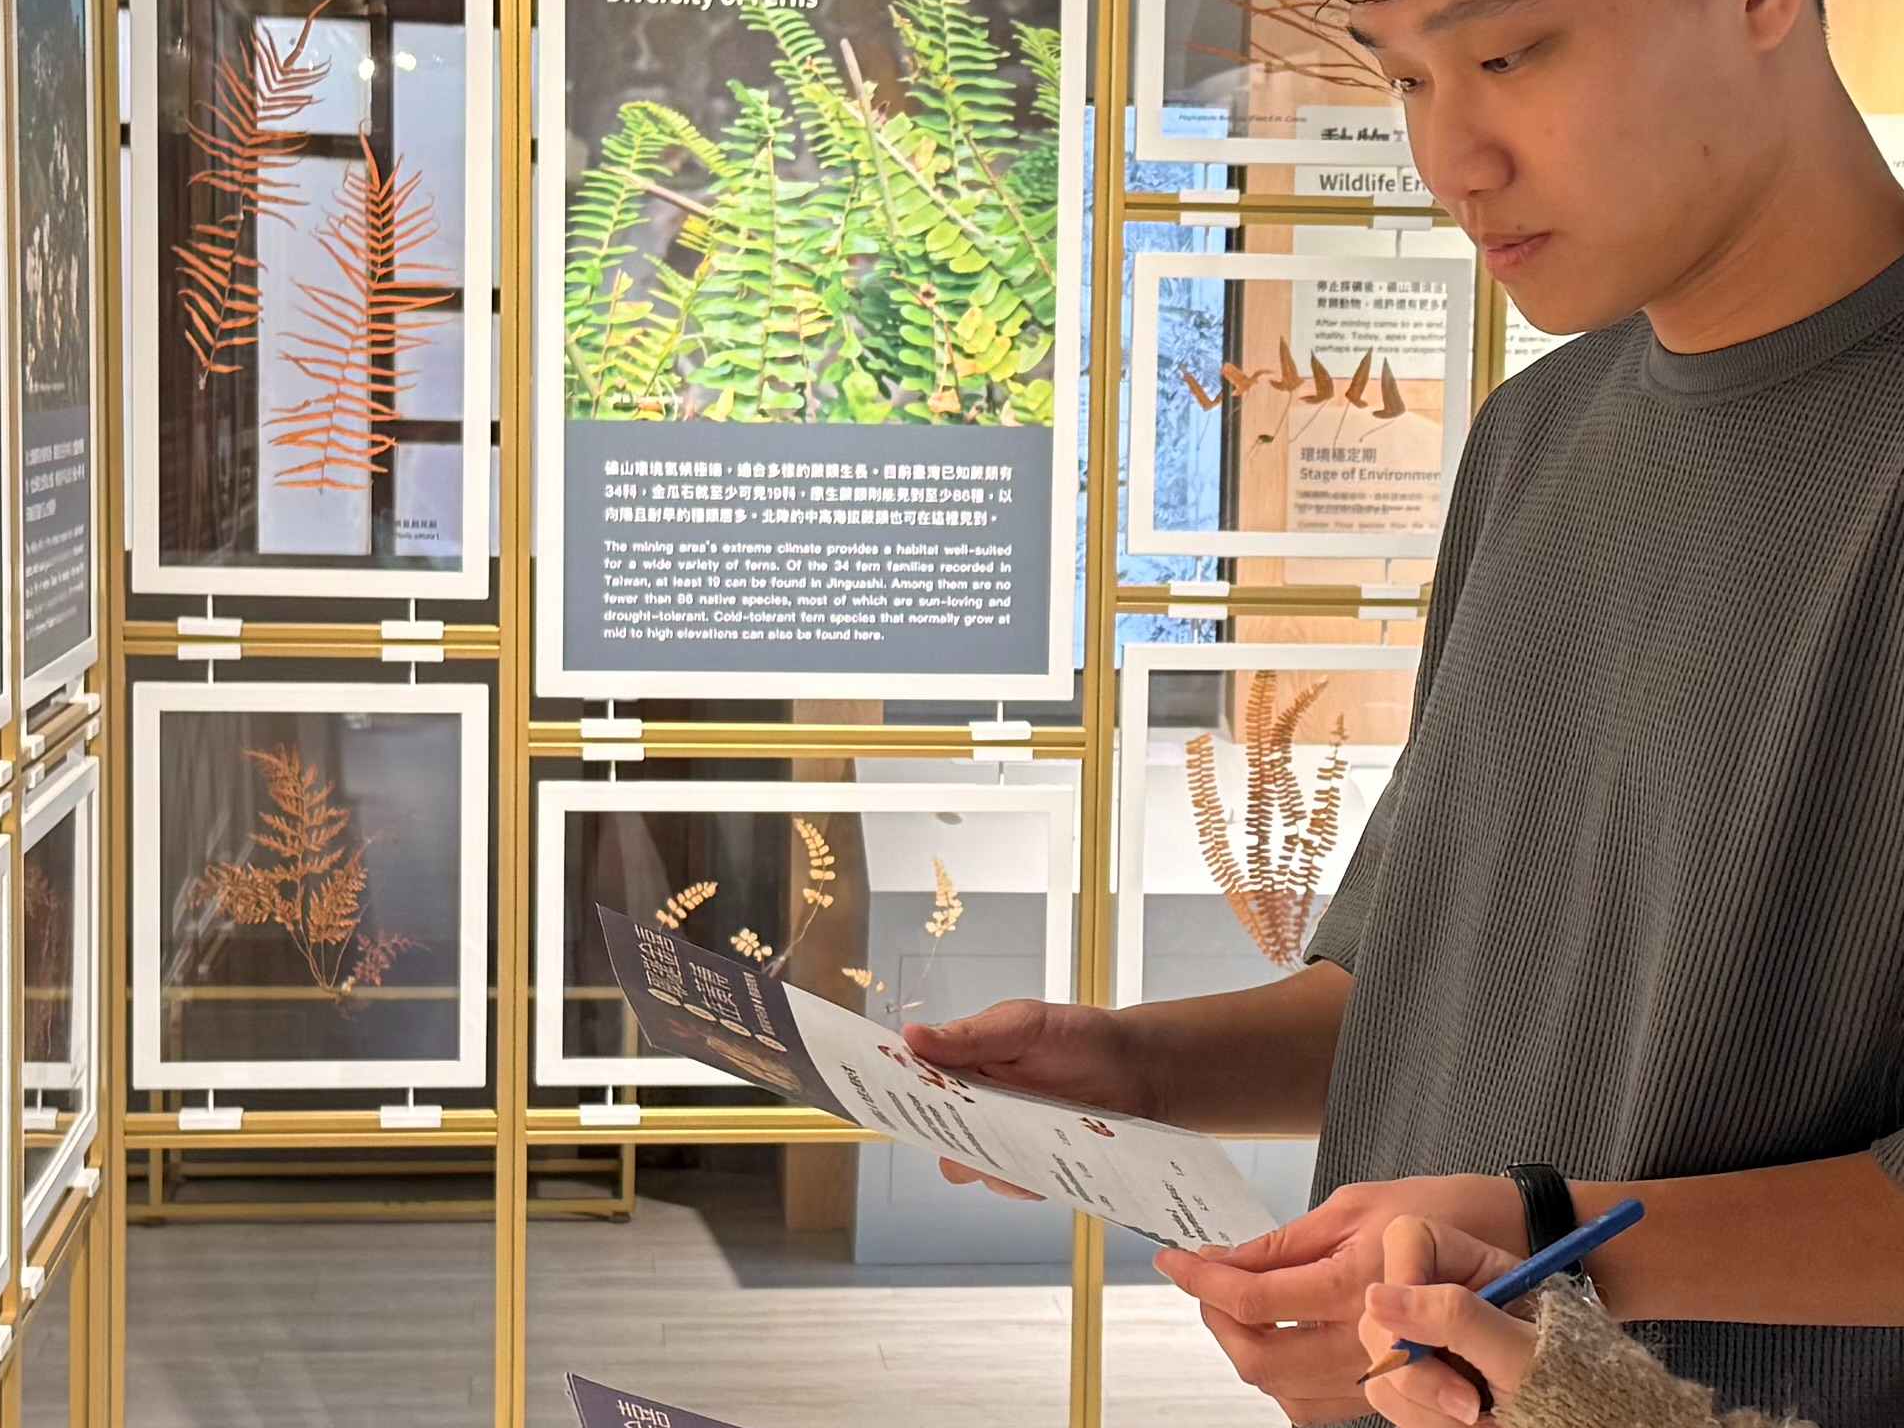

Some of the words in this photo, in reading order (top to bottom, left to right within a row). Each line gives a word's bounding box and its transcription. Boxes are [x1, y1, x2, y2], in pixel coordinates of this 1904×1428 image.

[1319, 173, 1396, 191] Wildlife
[1299, 447, 1377, 463] 環境穩定期
[1299, 468, 1338, 483] Stage
[1341, 467, 1354, 481] of
[603, 540, 627, 551] The
[631, 541, 674, 554] mining
[678, 540, 718, 552] area's
[721, 542, 772, 553] extreme
[776, 542, 822, 554] climate
[825, 542, 879, 556] provides
[883, 545, 892, 554] a
[895, 543, 939, 555] habitat
[943, 543, 1012, 555] well-suited
[603, 558, 622, 568] for
[627, 560, 637, 569] a
[641, 558, 672, 569] wide
[677, 558, 719, 572] variety
[724, 559, 739, 570] of
[744, 559, 780, 570] ferns.
[785, 559, 802, 570] Of
[807, 560, 828, 571] the
[833, 559, 849, 571] 34
[854, 560, 881, 571] fern
[885, 560, 934, 572] families
[939, 561, 994, 572] recorded
[999, 561, 1012, 572] in
[603, 575, 651, 587] Taiwan,
[655, 576, 668, 586] at
[671, 576, 702, 587] least
[706, 575, 721, 587] 19
[724, 578, 747, 587] can
[750, 576, 767, 587] be
[769, 576, 807, 588] found
[809, 577, 822, 588] in
[825, 577, 887, 591] Jinguashi.
[890, 577, 933, 591] Among
[937, 578, 968, 589] them
[971, 581, 992, 589] are
[995, 581, 1011, 589] no
[602, 592, 638, 603] fewer
[643, 592, 672, 604] than
[676, 593, 693, 604] 86
[698, 593, 736, 604] native
[741, 594, 792, 606] species,
[796, 595, 828, 605] most
[832, 594, 847, 605] of
[851, 594, 888, 605] which
[892, 597, 913, 606] are
[918, 595, 983, 608] sun-loving
[987, 596, 1011, 607] and
[602, 610, 709, 624] drought-tolerant.
[712, 610, 796, 622] Cold-tolerant
[799, 611, 825, 622] fern
[829, 612, 876, 625] species
[879, 612, 904, 623] that
[907, 612, 960, 625] normally
[963, 615, 994, 626] grow
[997, 614, 1010, 624] at
[603, 626, 627, 638] mid
[629, 627, 643, 638] to
[646, 627, 674, 641] high
[676, 627, 738, 638] elevations
[741, 630, 764, 639] can
[767, 628, 793, 639] also
[795, 628, 812, 639] be
[814, 628, 851, 640] found
[853, 629, 884, 640] here.
